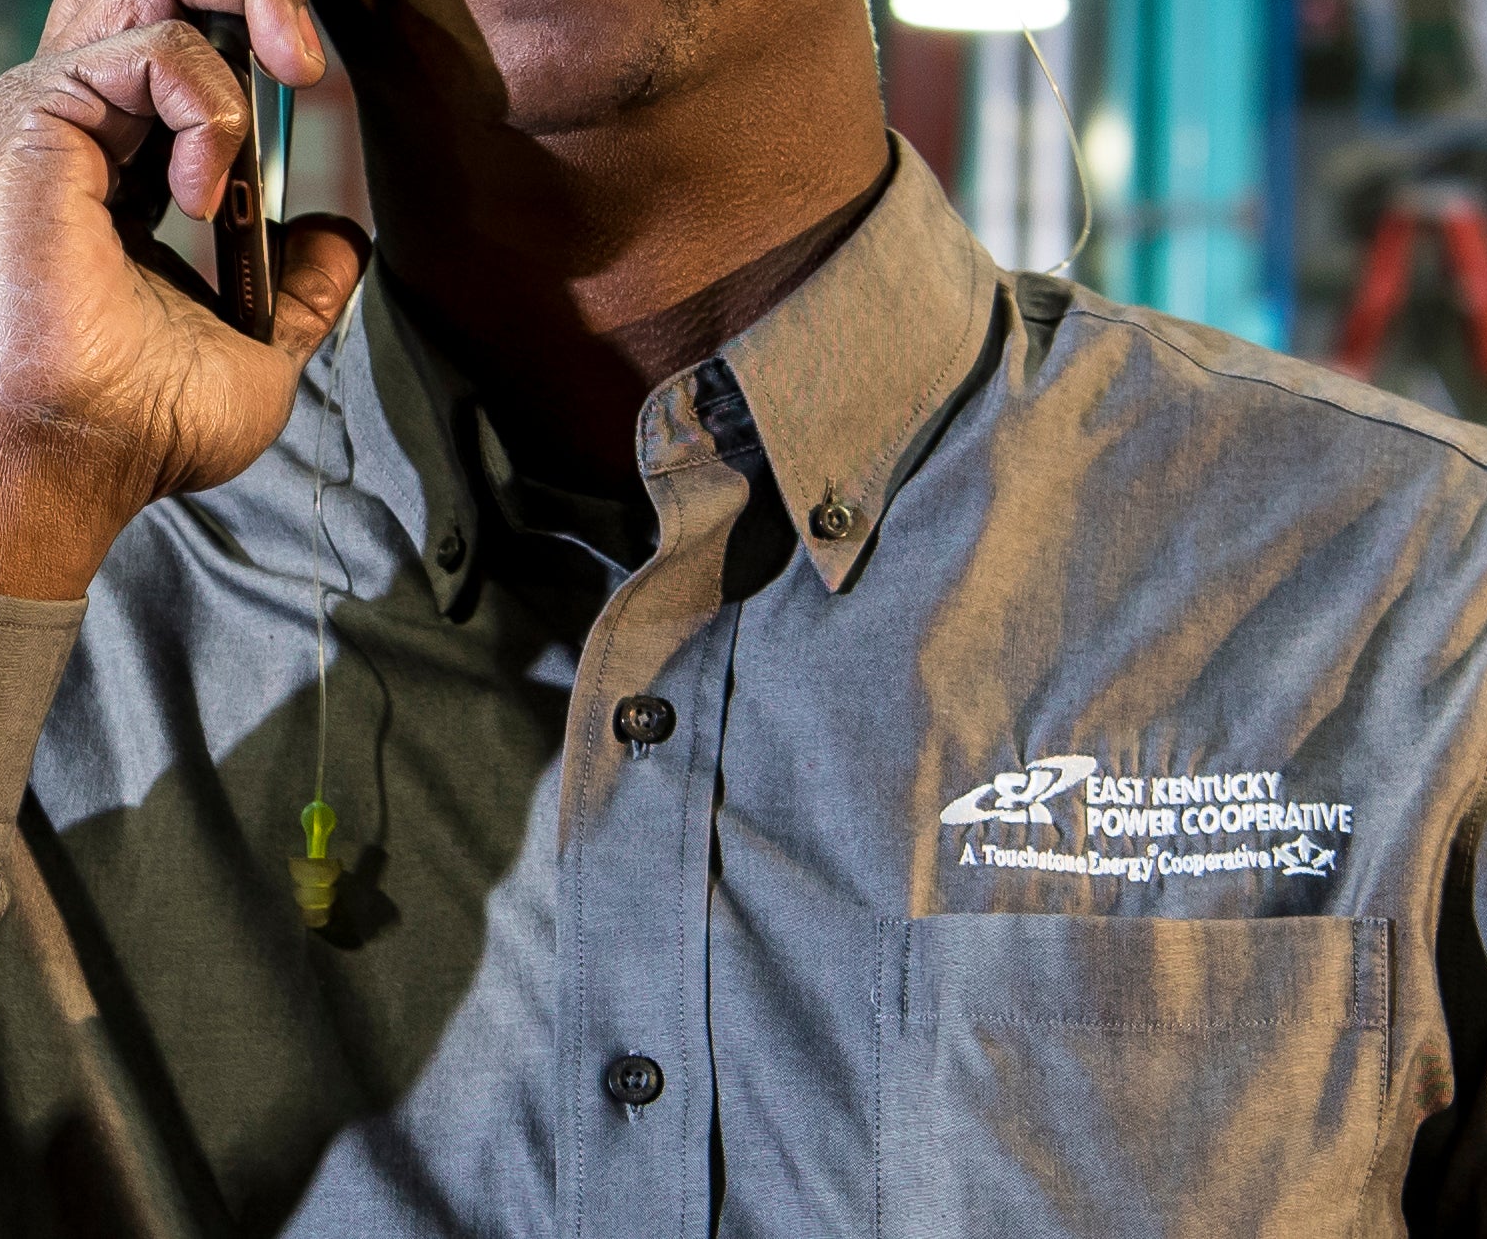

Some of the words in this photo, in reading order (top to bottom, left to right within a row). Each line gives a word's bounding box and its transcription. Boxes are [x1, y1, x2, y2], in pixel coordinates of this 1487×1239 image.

[1086, 774, 1145, 805] EAST
[1151, 771, 1281, 805] KENTUCKY
[1086, 806, 1177, 838] POWER
[1181, 801, 1353, 835] COOPERATIVE
[959, 842, 979, 866] A
[982, 844, 1087, 874] Touchstone
[1157, 843, 1271, 877] Cooperative
